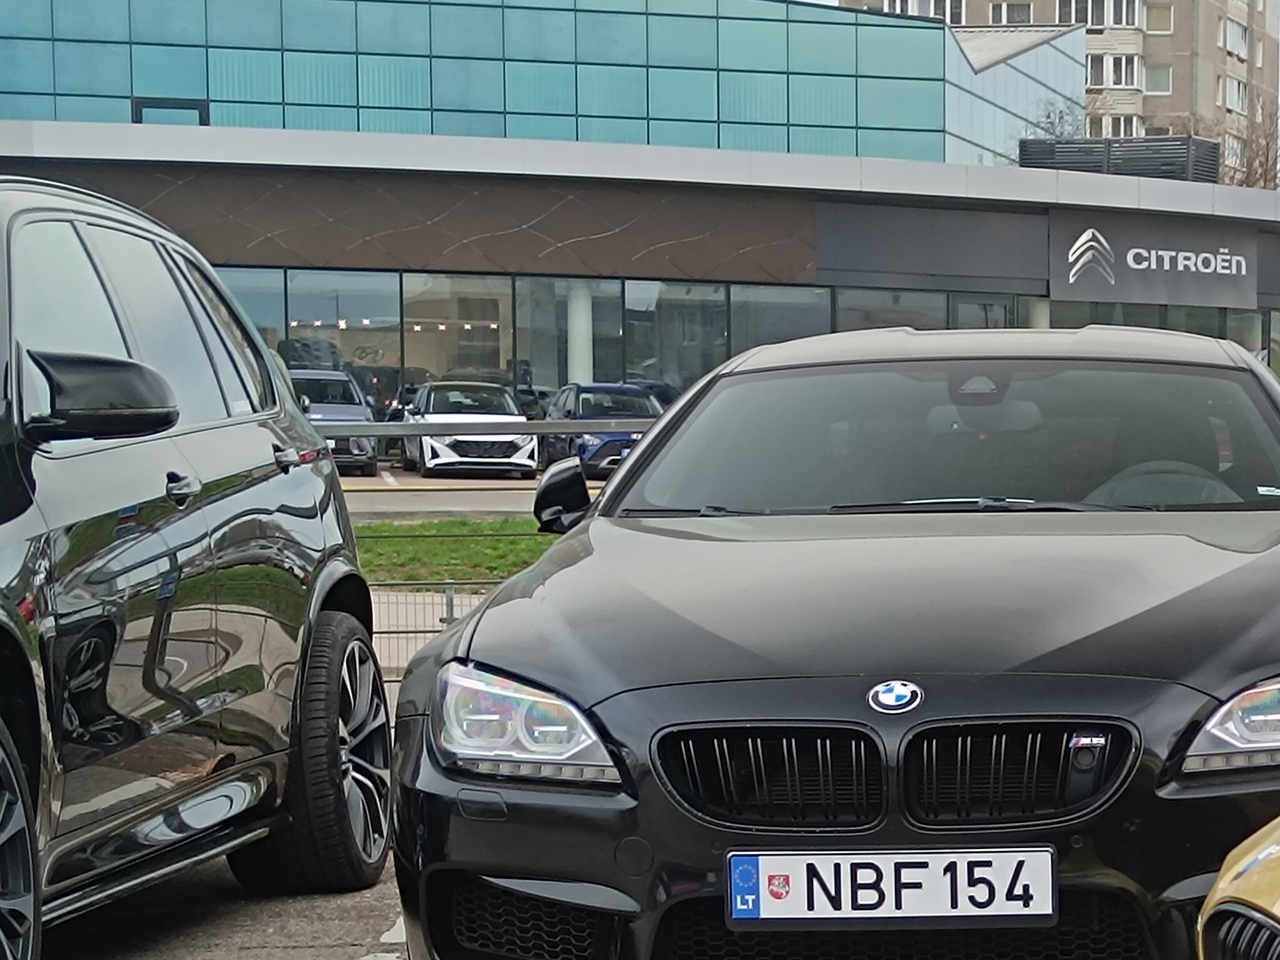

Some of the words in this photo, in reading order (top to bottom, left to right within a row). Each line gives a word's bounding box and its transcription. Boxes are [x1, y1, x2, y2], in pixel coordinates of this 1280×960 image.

[1126, 247, 1247, 276] CITROËN
[805, 860, 930, 912] NBF
[942, 858, 1034, 910] 154
[735, 894, 756, 910] LT
